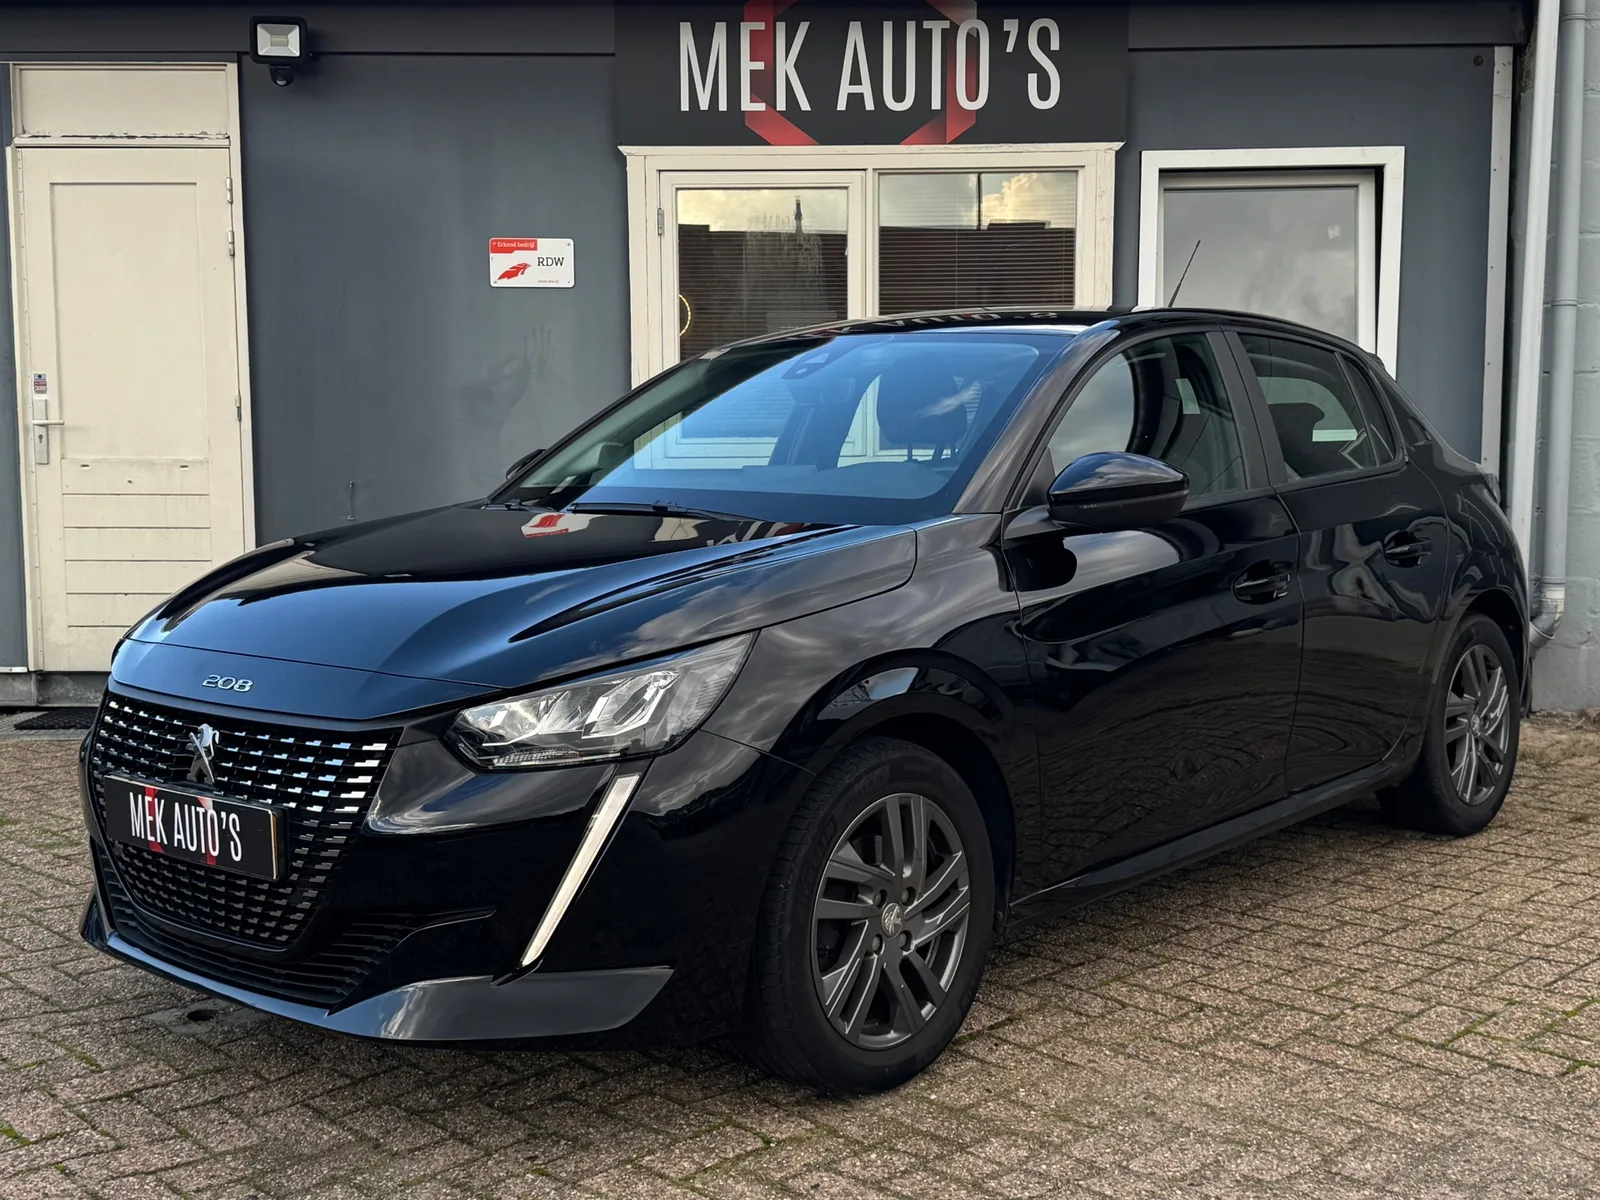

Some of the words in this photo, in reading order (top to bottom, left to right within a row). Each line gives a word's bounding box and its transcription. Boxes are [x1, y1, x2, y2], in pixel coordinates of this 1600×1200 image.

[679, 20, 812, 112] MEK
[836, 17, 1061, 112] AUTO'S
[517, 241, 535, 249] bedrijf
[537, 256, 565, 267] RDW
[201, 673, 254, 693] 208
[128, 791, 168, 846] MEK
[173, 800, 243, 863] AUTO'S
